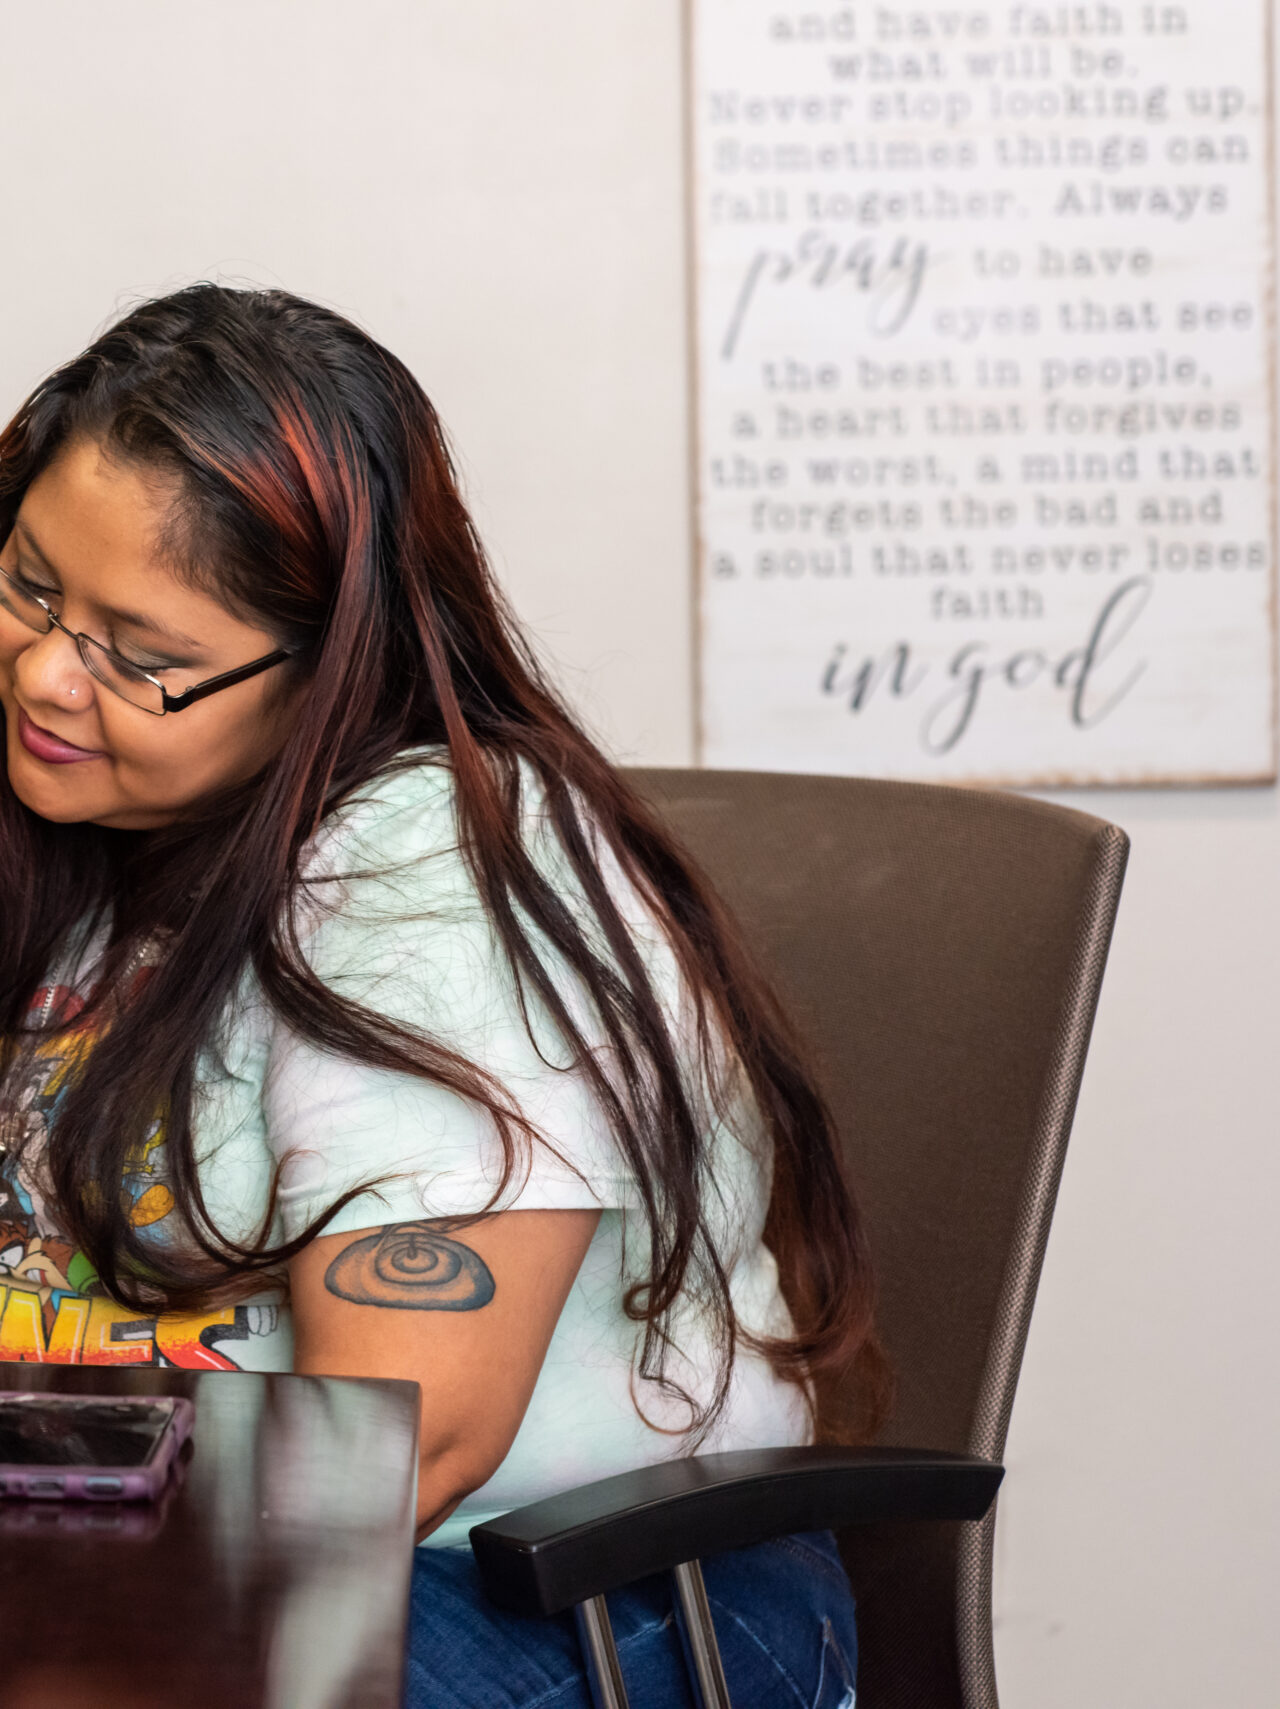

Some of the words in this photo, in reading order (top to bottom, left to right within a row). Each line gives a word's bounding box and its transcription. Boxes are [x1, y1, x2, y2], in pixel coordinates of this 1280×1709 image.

[769, 4, 857, 42] and
[875, 5, 991, 40] have
[1008, 3, 1123, 38] faith
[1140, 1, 1190, 36] in
[826, 44, 948, 84] what
[963, 45, 1053, 82] will
[1067, 45, 1139, 80] be.
[708, 91, 853, 125] Never
[868, 90, 972, 128] stop
[989, 86, 1171, 122] looking
[1183, 85, 1261, 122] up.
[714, 136, 978, 174] Sometimes
[993, 130, 1150, 172] things
[1163, 134, 1251, 167] can
[709, 188, 790, 226] fall
[804, 186, 1027, 226] together.
[1052, 179, 1229, 222] Always
[721, 228, 934, 362] pray
[971, 247, 1022, 280] to
[1035, 241, 1159, 280] have
[934, 306, 1041, 343] eyes
[1057, 296, 1162, 334] that
[1174, 301, 1256, 334] see
[761, 357, 842, 393] the
[854, 354, 960, 391] best
[974, 355, 1022, 390] in
[1039, 349, 1213, 392] people,
[729, 409, 762, 442] a
[772, 402, 910, 442] heart
[923, 400, 1028, 438] that
[1041, 398, 1244, 440] forgives
[709, 456, 789, 489] the
[804, 451, 958, 490] worst,
[974, 453, 1005, 486] a
[1019, 448, 1141, 485] mind
[1156, 445, 1262, 484] that
[748, 498, 923, 538] forgets
[936, 495, 1019, 531] the
[1032, 492, 1120, 529] bad
[1134, 490, 1226, 526] and
[711, 549, 739, 580] a
[753, 544, 855, 580] soul
[869, 542, 976, 578] that
[989, 542, 1132, 575] never
[1144, 540, 1268, 574] loses
[929, 584, 1046, 622] faith
[819, 640, 928, 715] in
[918, 573, 1154, 758] god
